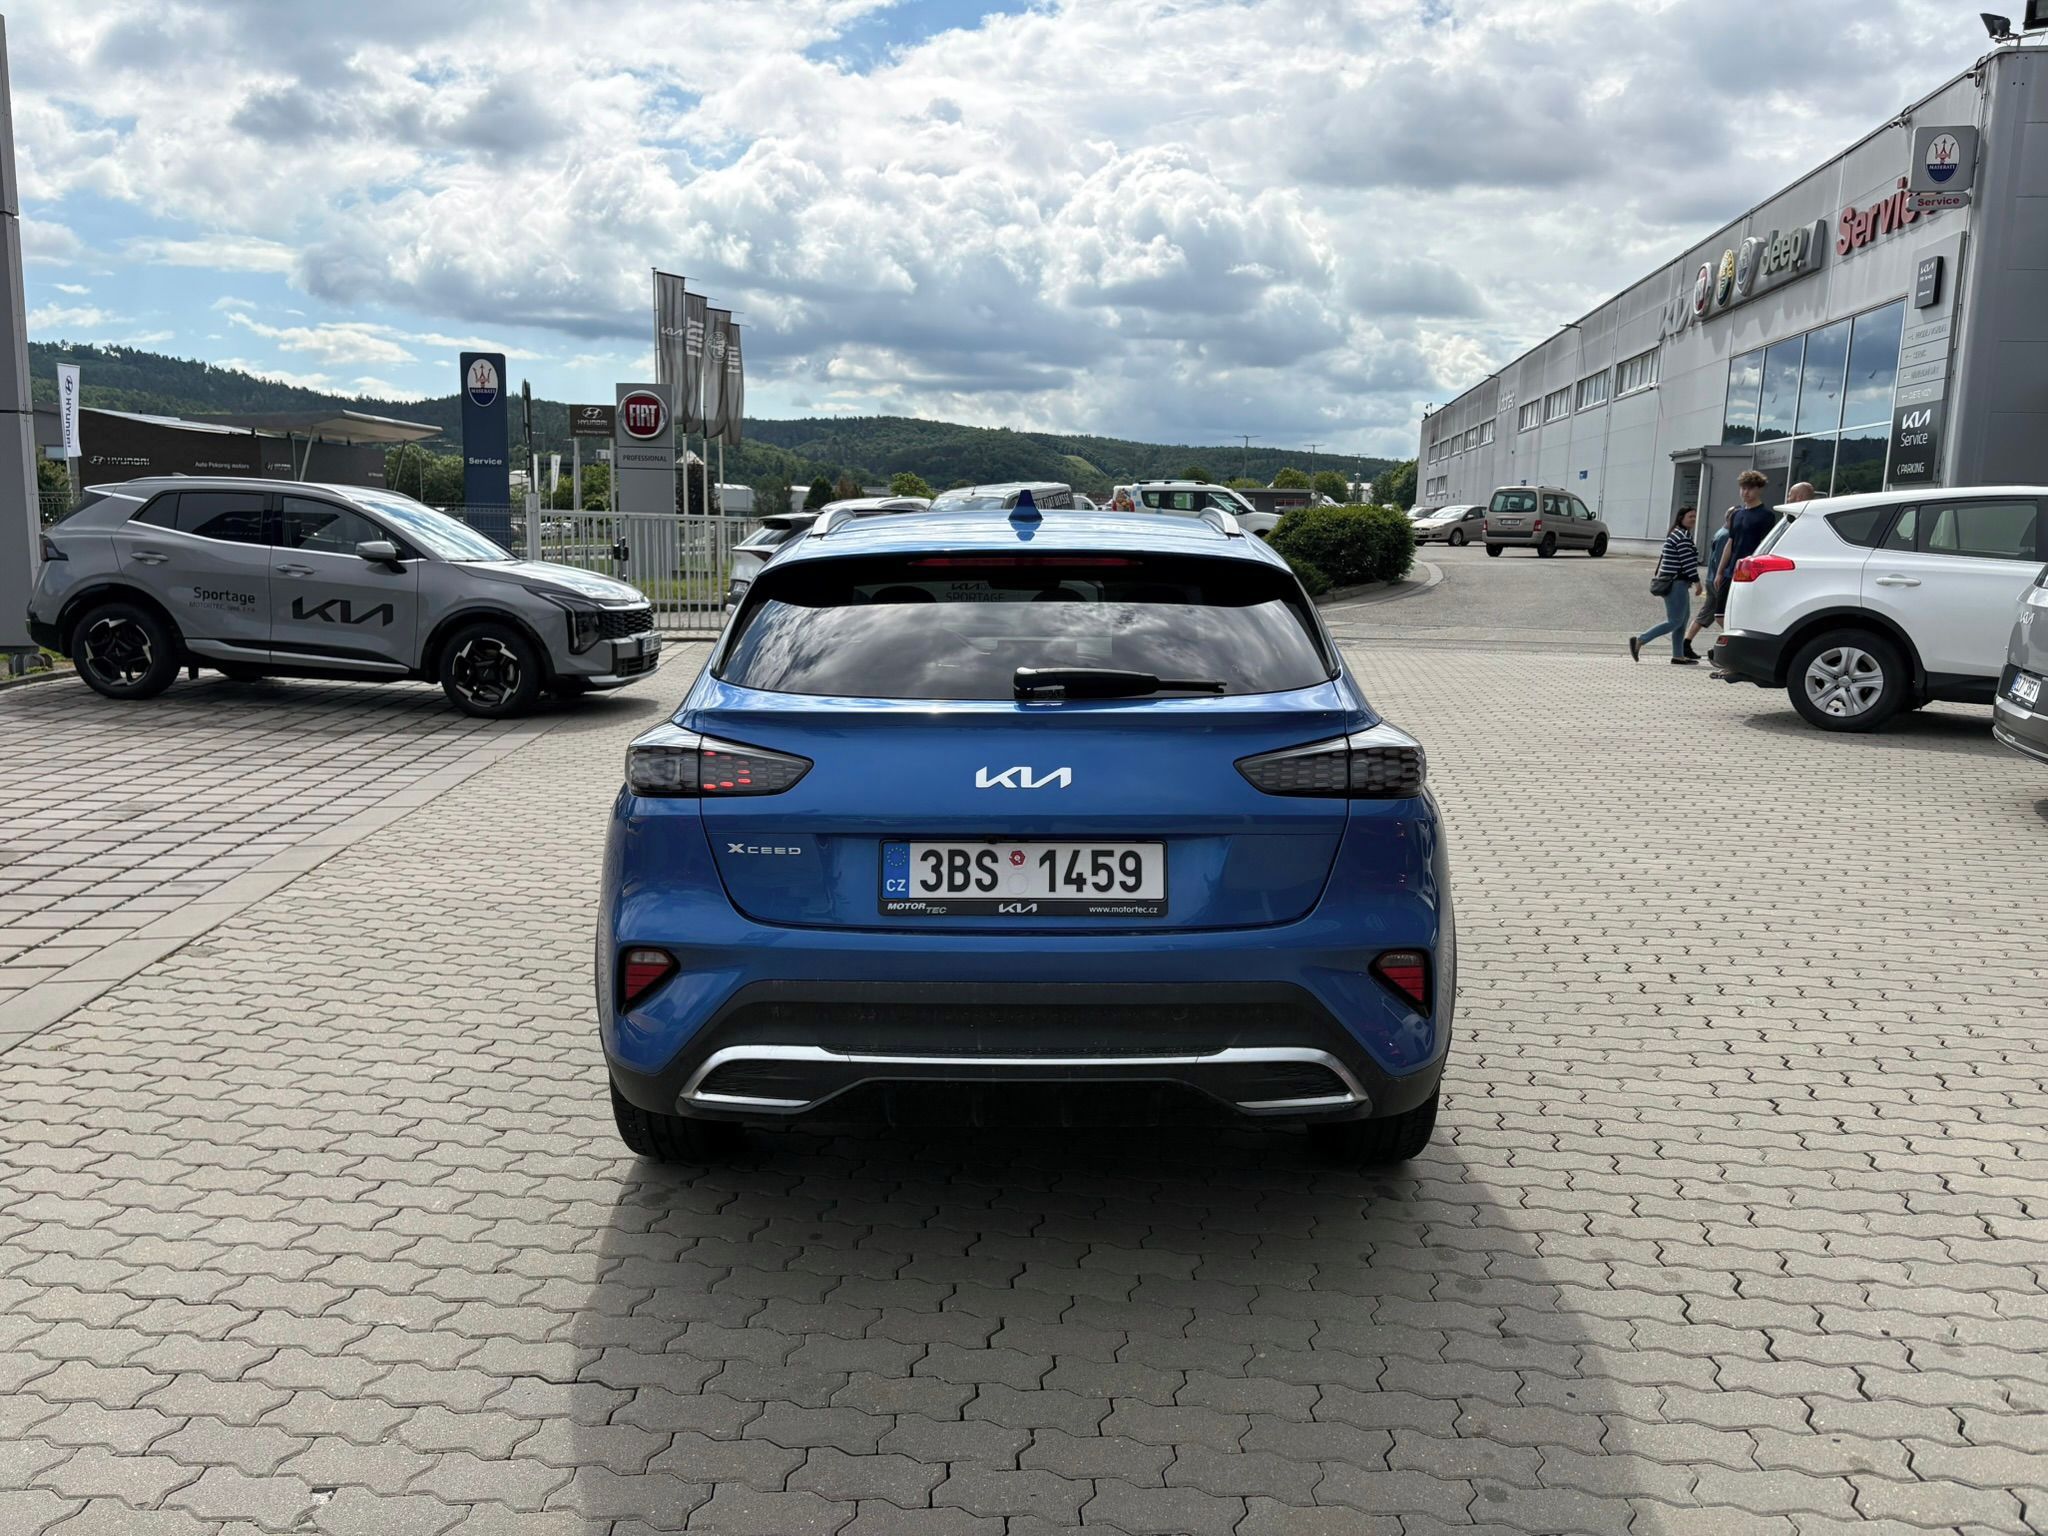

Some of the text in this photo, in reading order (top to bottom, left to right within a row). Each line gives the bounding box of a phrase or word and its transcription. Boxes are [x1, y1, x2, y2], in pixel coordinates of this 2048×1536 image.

[1917, 197, 1960, 207] Service
[1837, 176, 1938, 255] Servic
[1760, 229, 1808, 275] Jeep
[686, 317, 704, 358] FIAT
[628, 404, 657, 427] FIAT
[1901, 409, 1931, 430] KIA
[1900, 430, 1928, 448] Service
[107, 456, 150, 466] HYUNDAI
[468, 457, 503, 465] Service
[622, 454, 667, 462] PROFESSIONAL
[1900, 461, 1925, 475] PARKING
[193, 586, 256, 606] Sportage
[945, 591, 1006, 602] SPORTAGE
[291, 596, 394, 628] KIA
[975, 766, 1072, 788] KIA
[919, 848, 1143, 893] 3BS 1459
[885, 879, 907, 892] CZ
[998, 903, 1038, 914] KIA
[1088, 905, 1158, 914] www.motortec.cz
